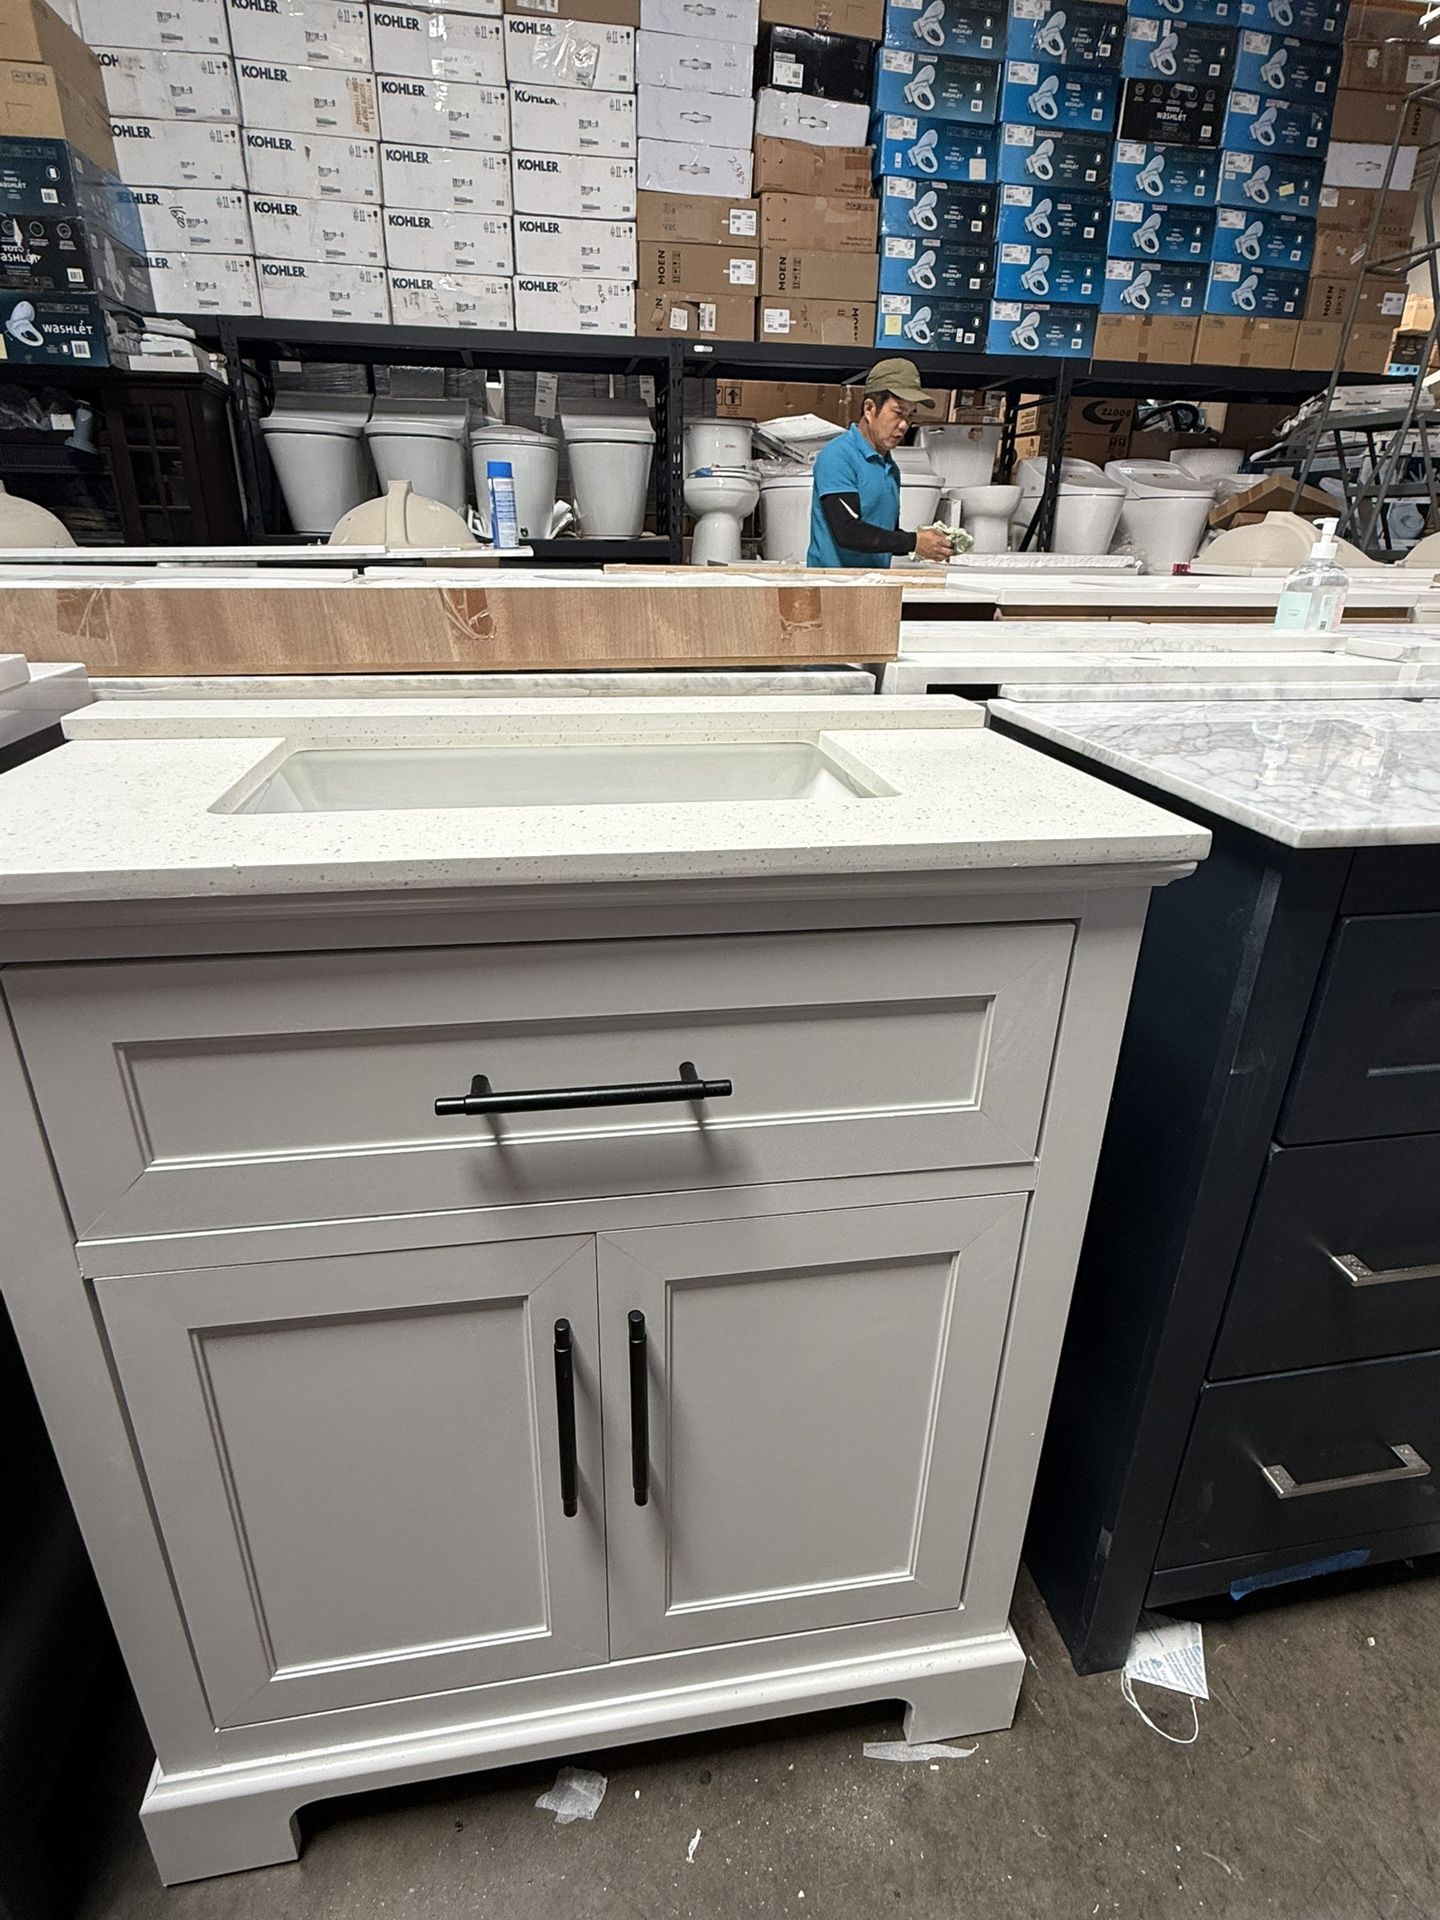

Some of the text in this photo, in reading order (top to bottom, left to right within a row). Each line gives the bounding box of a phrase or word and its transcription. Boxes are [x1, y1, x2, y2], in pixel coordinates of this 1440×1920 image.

[232, 0, 278, 14] KOHLER
[374, 14, 420, 31] KOHLER
[241, 64, 288, 82] KOHLER
[382, 81, 426, 97] KOHLER
[112, 124, 152, 139] OHLER
[247, 134, 293, 151] KOHLER
[386, 149, 429, 164] KOHLER
[518, 158, 559, 173] KOHLER
[254, 201, 299, 216] KOHLER
[388, 215, 432, 228] KOHLER
[520, 220, 560, 234] KOHLER
[262, 264, 306, 278] KOHLER
[658, 250, 666, 285] MOEN
[778, 256, 787, 290] MOEN
[392, 278, 434, 290] KOHLER
[518, 280, 558, 292] KOHLER
